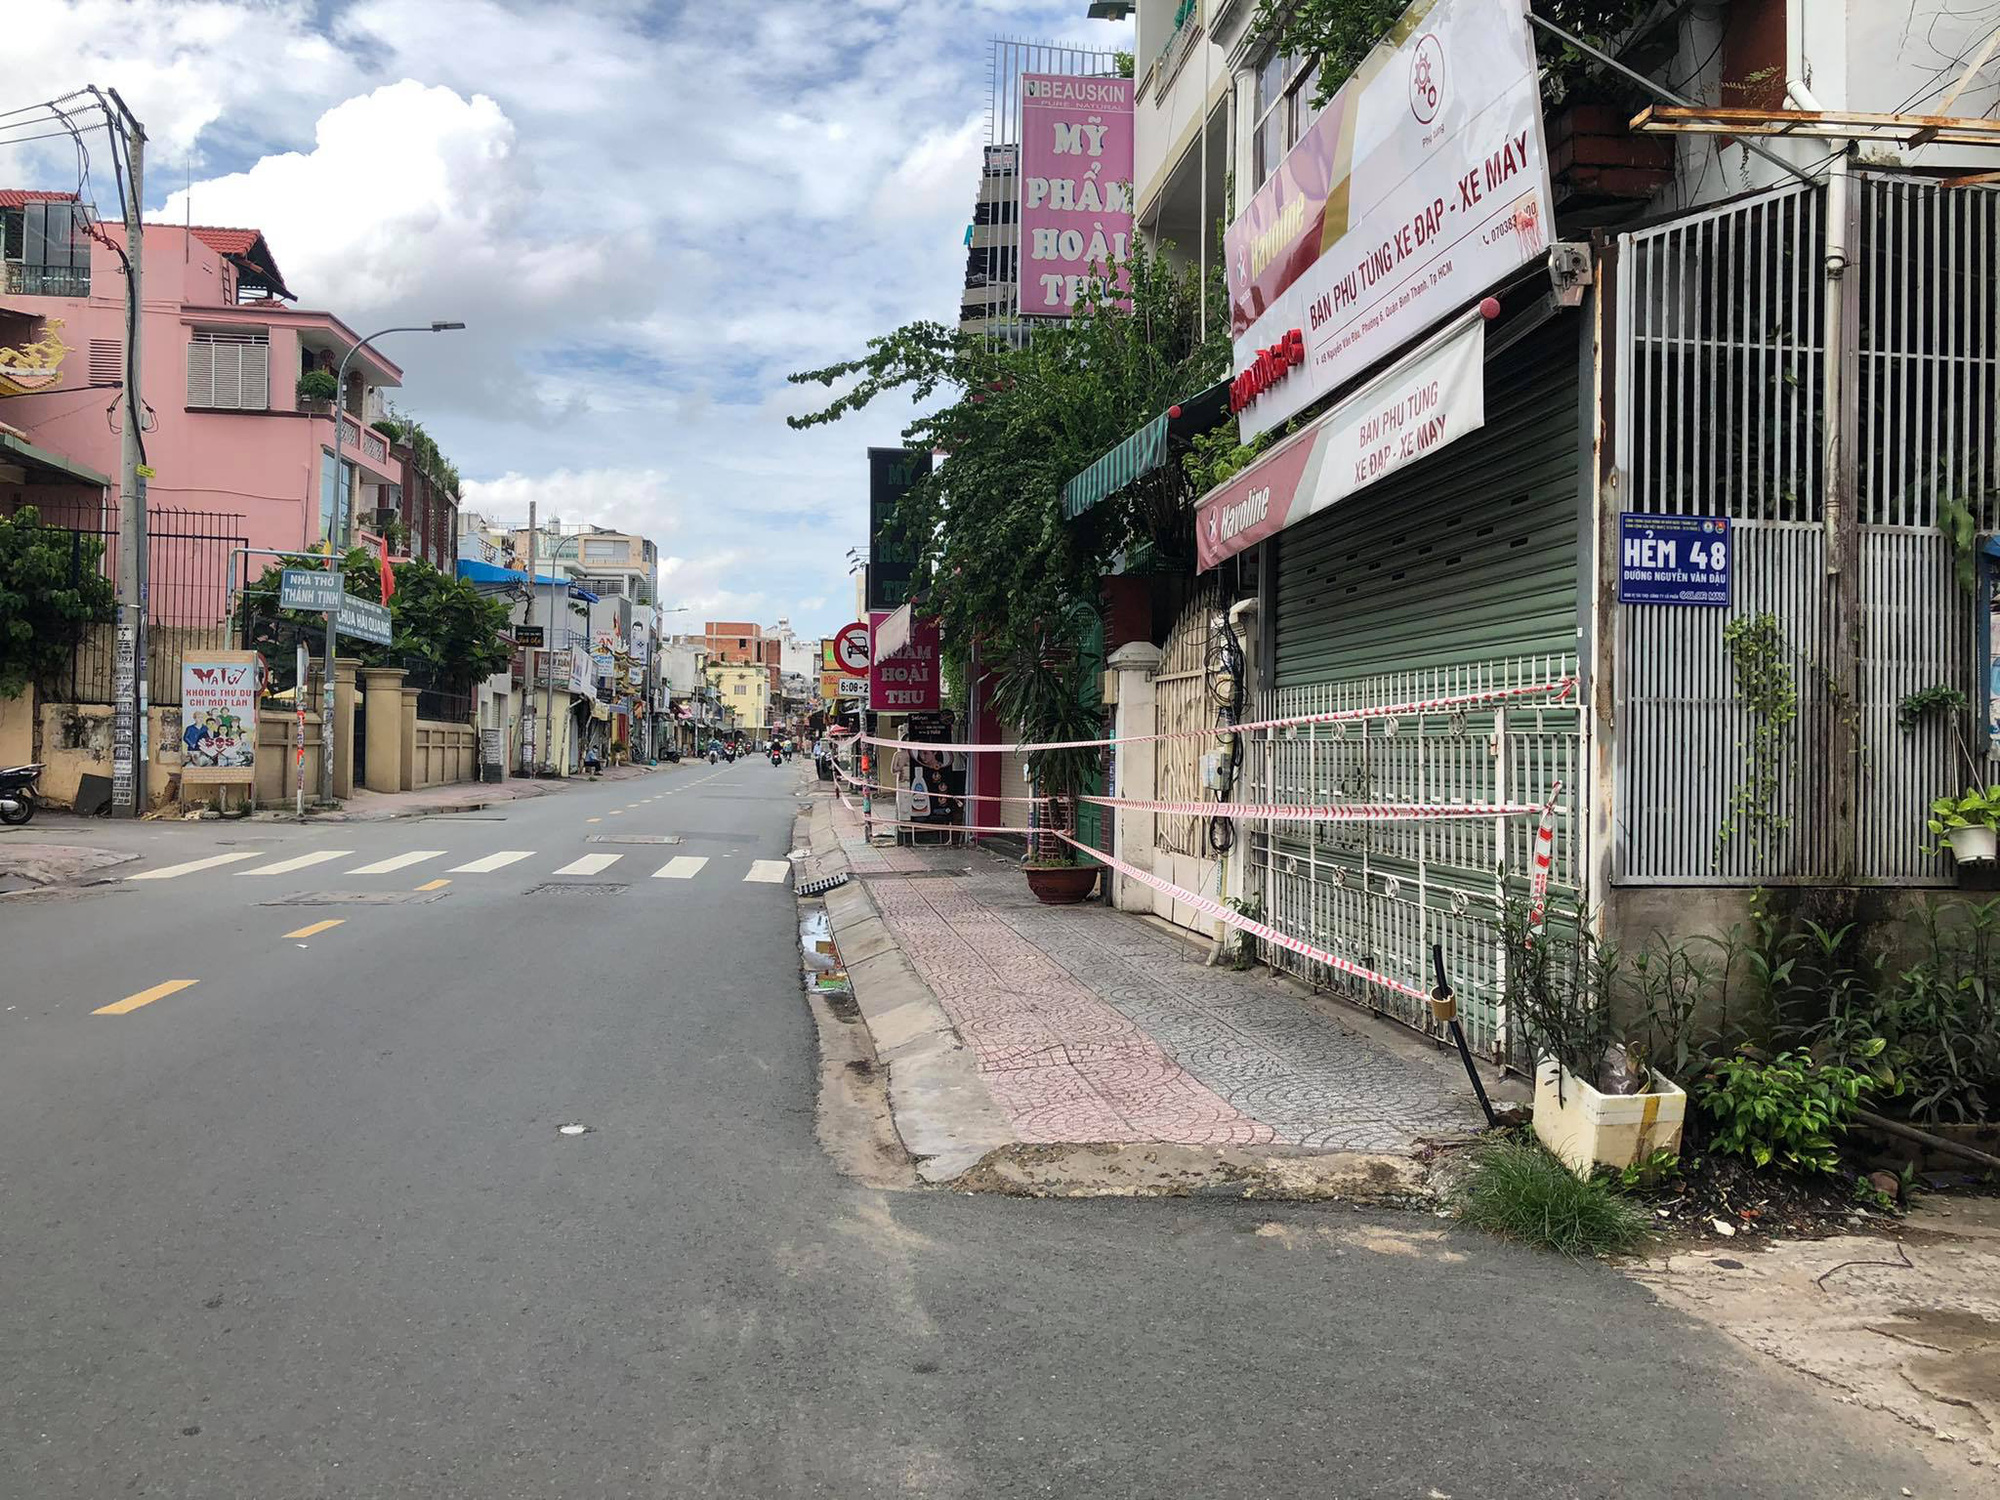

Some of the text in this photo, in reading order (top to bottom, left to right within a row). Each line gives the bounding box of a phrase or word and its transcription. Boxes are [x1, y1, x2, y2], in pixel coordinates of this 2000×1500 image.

[1041, 82, 1125, 103] BEAUSKIN
[1052, 116, 1109, 156] MỸ
[1025, 161, 1133, 213] PHẨM
[1031, 222, 1128, 262] HOÀI
[1310, 292, 1332, 331] BÁN
[1333, 271, 1357, 312] PHỤ
[1358, 242, 1393, 291] TÙNG
[1393, 224, 1413, 263] XE
[1414, 197, 1444, 249] ĐẠP
[1458, 168, 1482, 213] XE
[1485, 130, 1528, 192] MÁY
[1437, 260, 1453, 279] HCM
[1359, 381, 1438, 448] BÁN PHỤ TÙNG
[1354, 457, 1367, 485] XE
[1369, 445, 1391, 477] ĐẠP
[1400, 431, 1414, 460] XE
[1417, 413, 1446, 451] MÁY
[1219, 484, 1270, 544] Havoline
[1624, 529, 1726, 570] HẺM 48
[284, 587, 314, 603] THÁNH
[318, 591, 339, 607] TỊNH
[290, 574, 311, 586] NHÀ
[1624, 568, 1726, 586] ĐƯỜNG NGUYỄN VĂN ĐẬU
[368, 617, 390, 636] QUANG
[885, 689, 925, 704] THU
